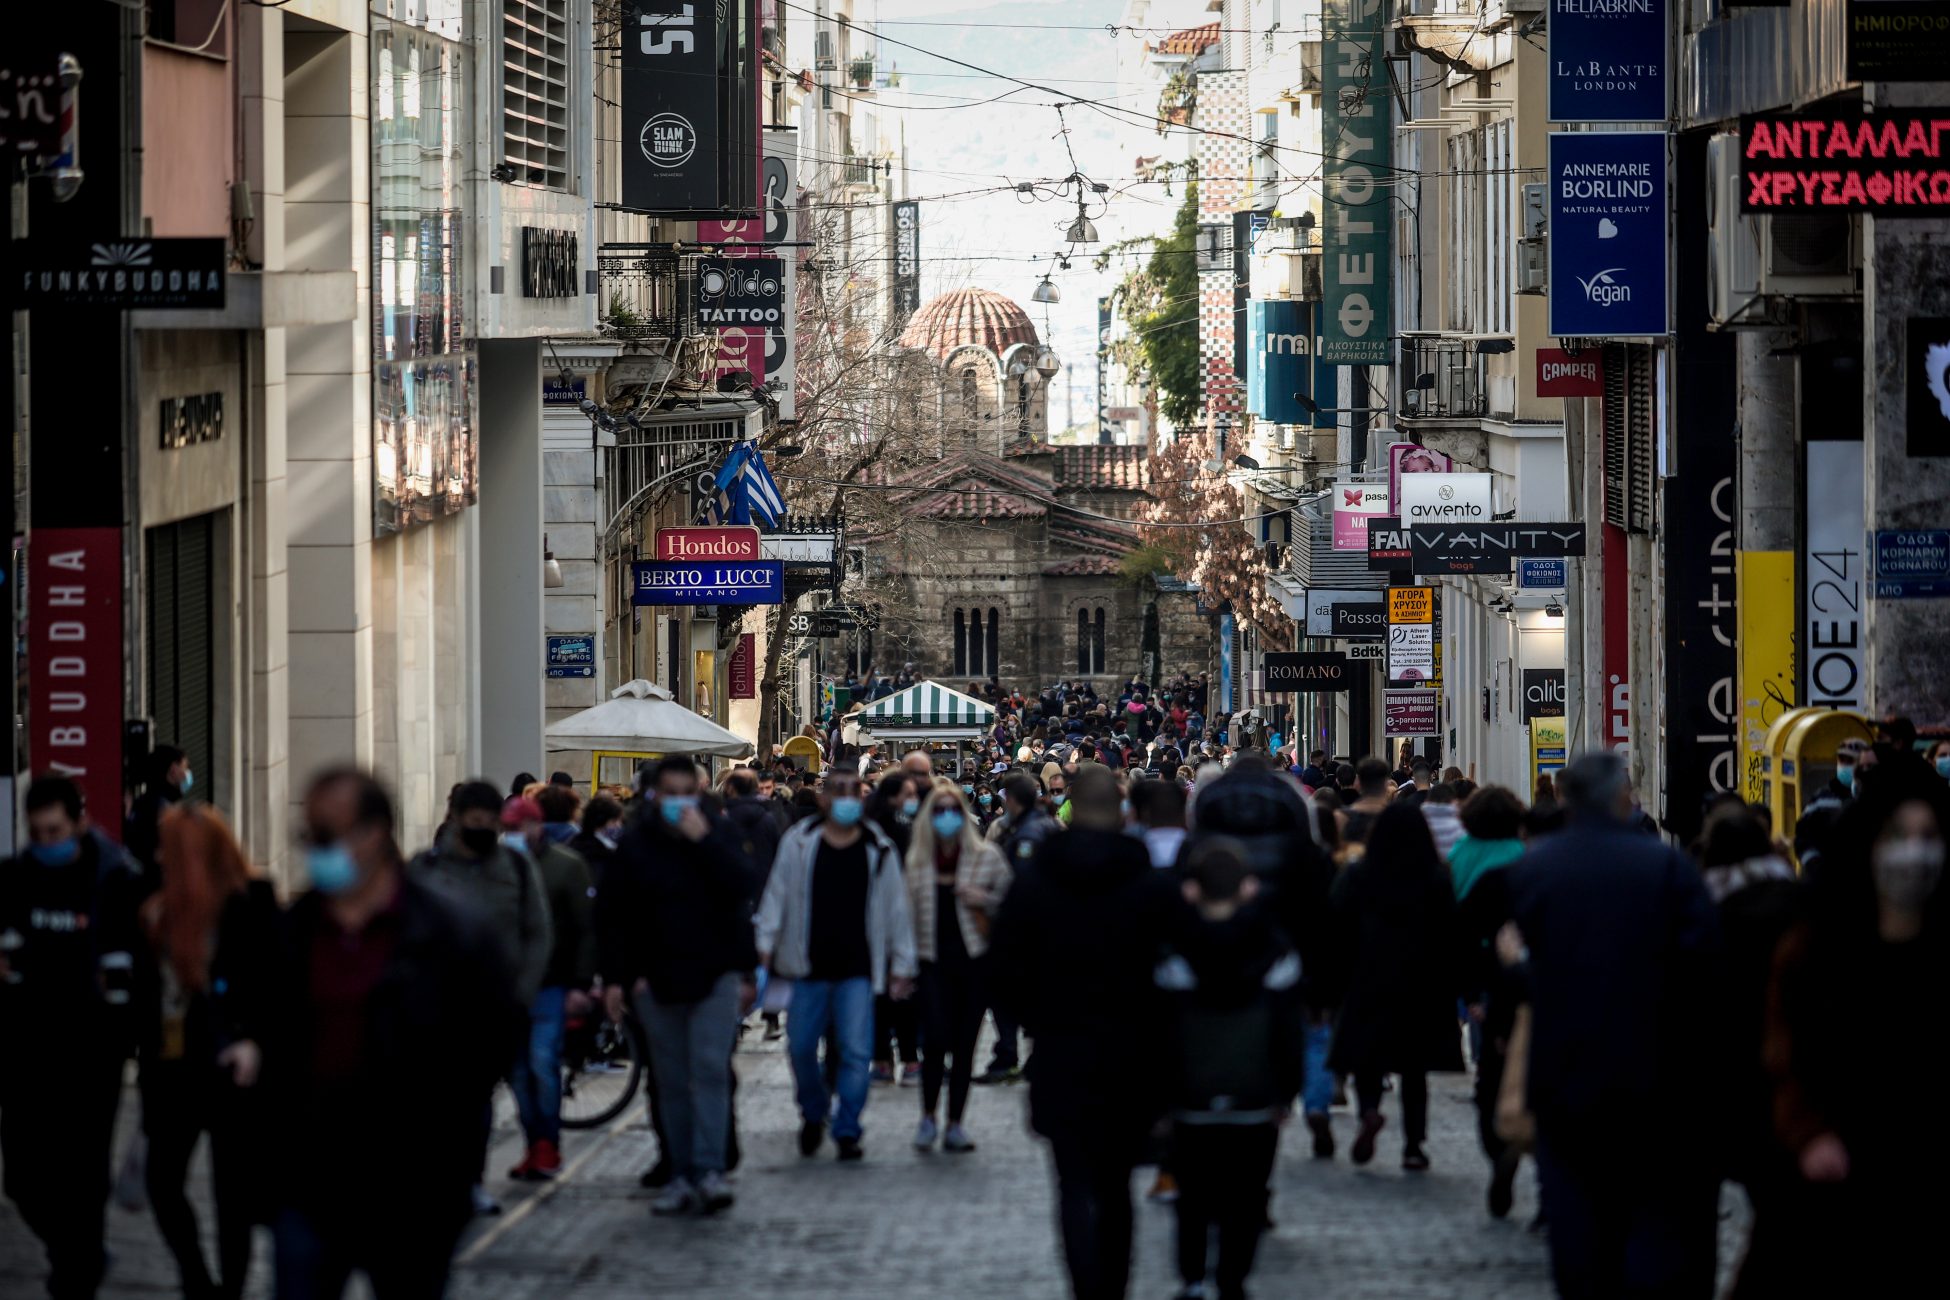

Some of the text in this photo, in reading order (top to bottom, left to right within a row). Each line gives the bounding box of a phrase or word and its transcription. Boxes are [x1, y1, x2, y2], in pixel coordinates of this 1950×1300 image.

[1574, 81, 1637, 91] LONDON
[653, 127, 683, 140] SLAM
[654, 141, 683, 153] DUNK
[1562, 163, 1651, 177] ANNEMARIE
[1562, 178, 1653, 198] BÖRLIND
[701, 264, 778, 302] Dildo
[1575, 268, 1631, 306] Vegan
[700, 308, 779, 322] TATTOO
[1542, 362, 1596, 382] CAMPER
[1411, 502, 1482, 516] avvento
[666, 535, 751, 555] Hondos
[1415, 530, 1581, 550] VANITY
[1896, 534, 1935, 545] ΟΔΟΣ
[1450, 562, 1474, 571] bags
[640, 570, 702, 585] BERTO
[675, 589, 738, 597] MILANO
[1396, 590, 1425, 600] ΑΓΟΡΑ
[1393, 601, 1428, 610] ΧΡΥΣΟΥ
[1351, 646, 1385, 657] Bdtk
[1268, 666, 1341, 679] ROMANO
